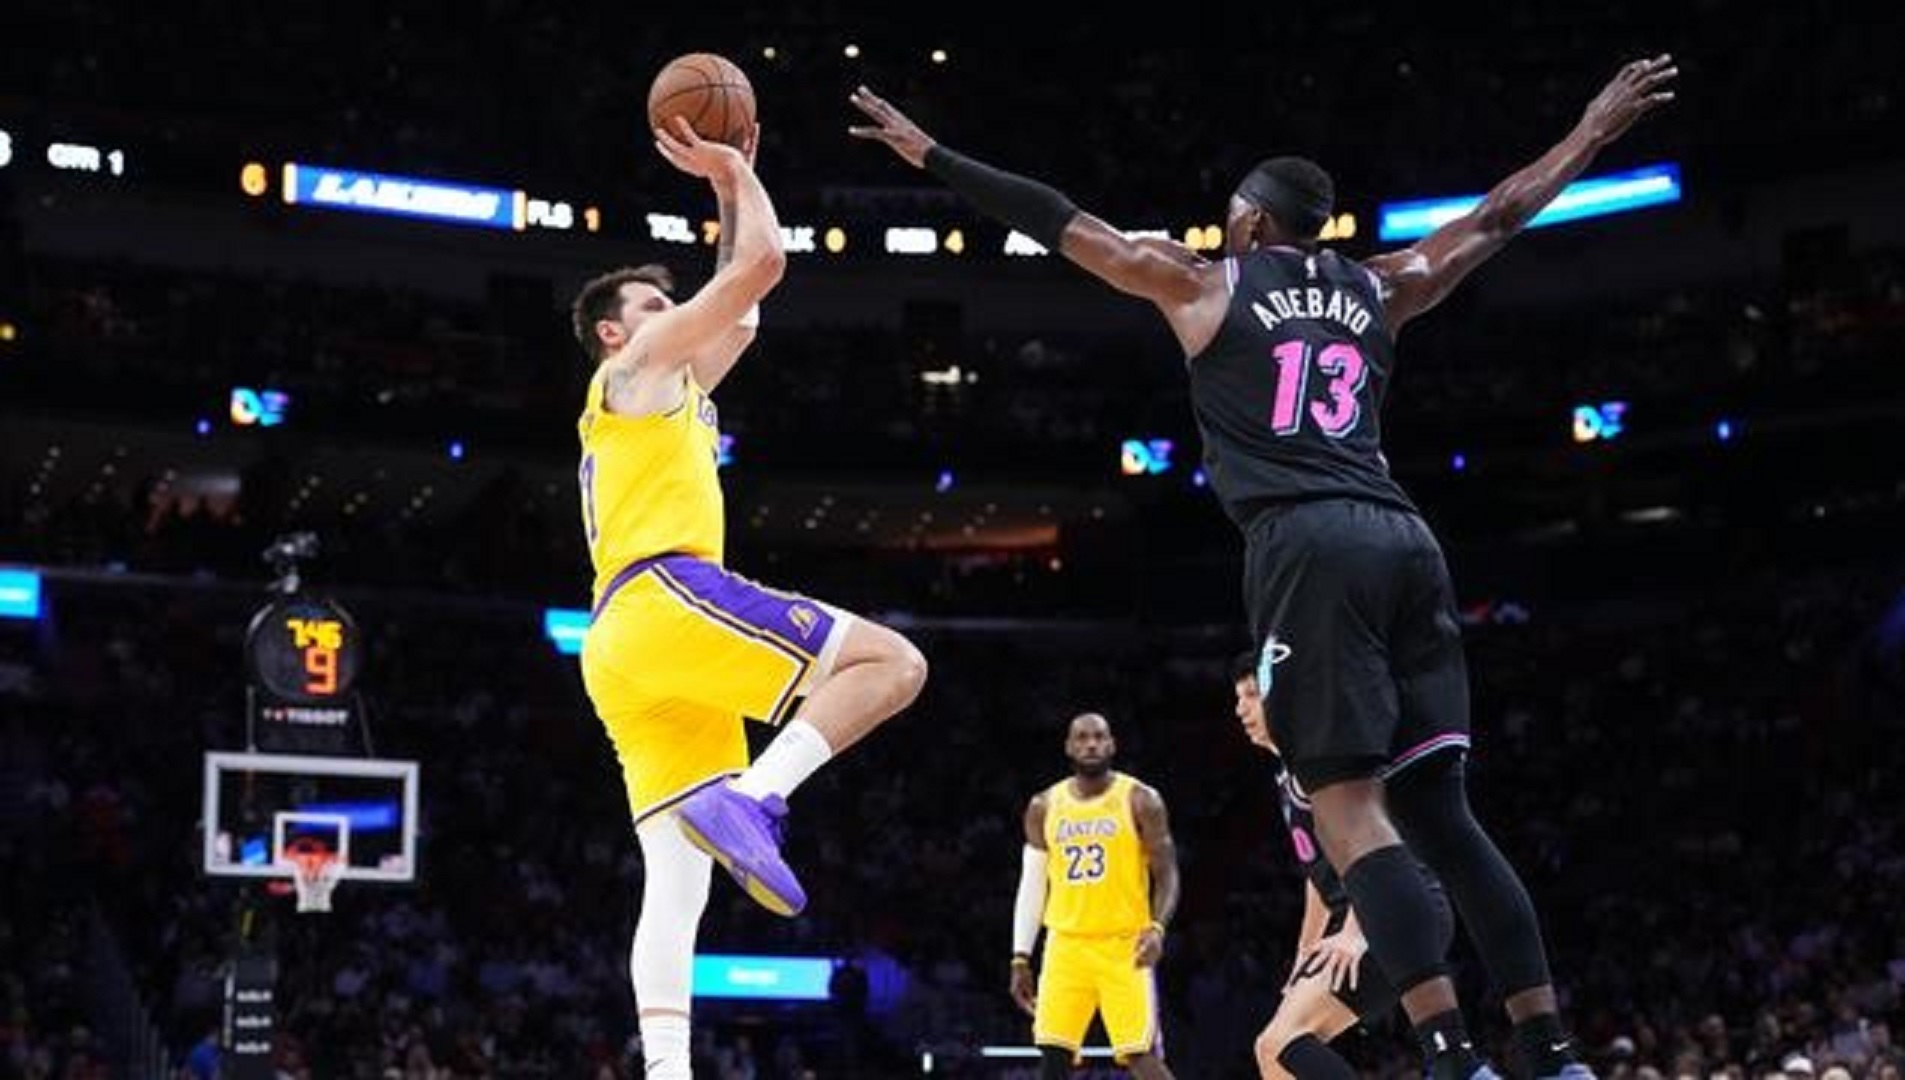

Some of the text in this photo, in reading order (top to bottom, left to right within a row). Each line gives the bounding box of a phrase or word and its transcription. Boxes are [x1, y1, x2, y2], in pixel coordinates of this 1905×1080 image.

[107, 149, 124, 176] 1
[584, 207, 600, 232] 1
[1251, 287, 1372, 335] ADEBAYO
[1271, 340, 1369, 439] 13
[306, 645, 337, 694] 9
[1065, 844, 1105, 880] 23
